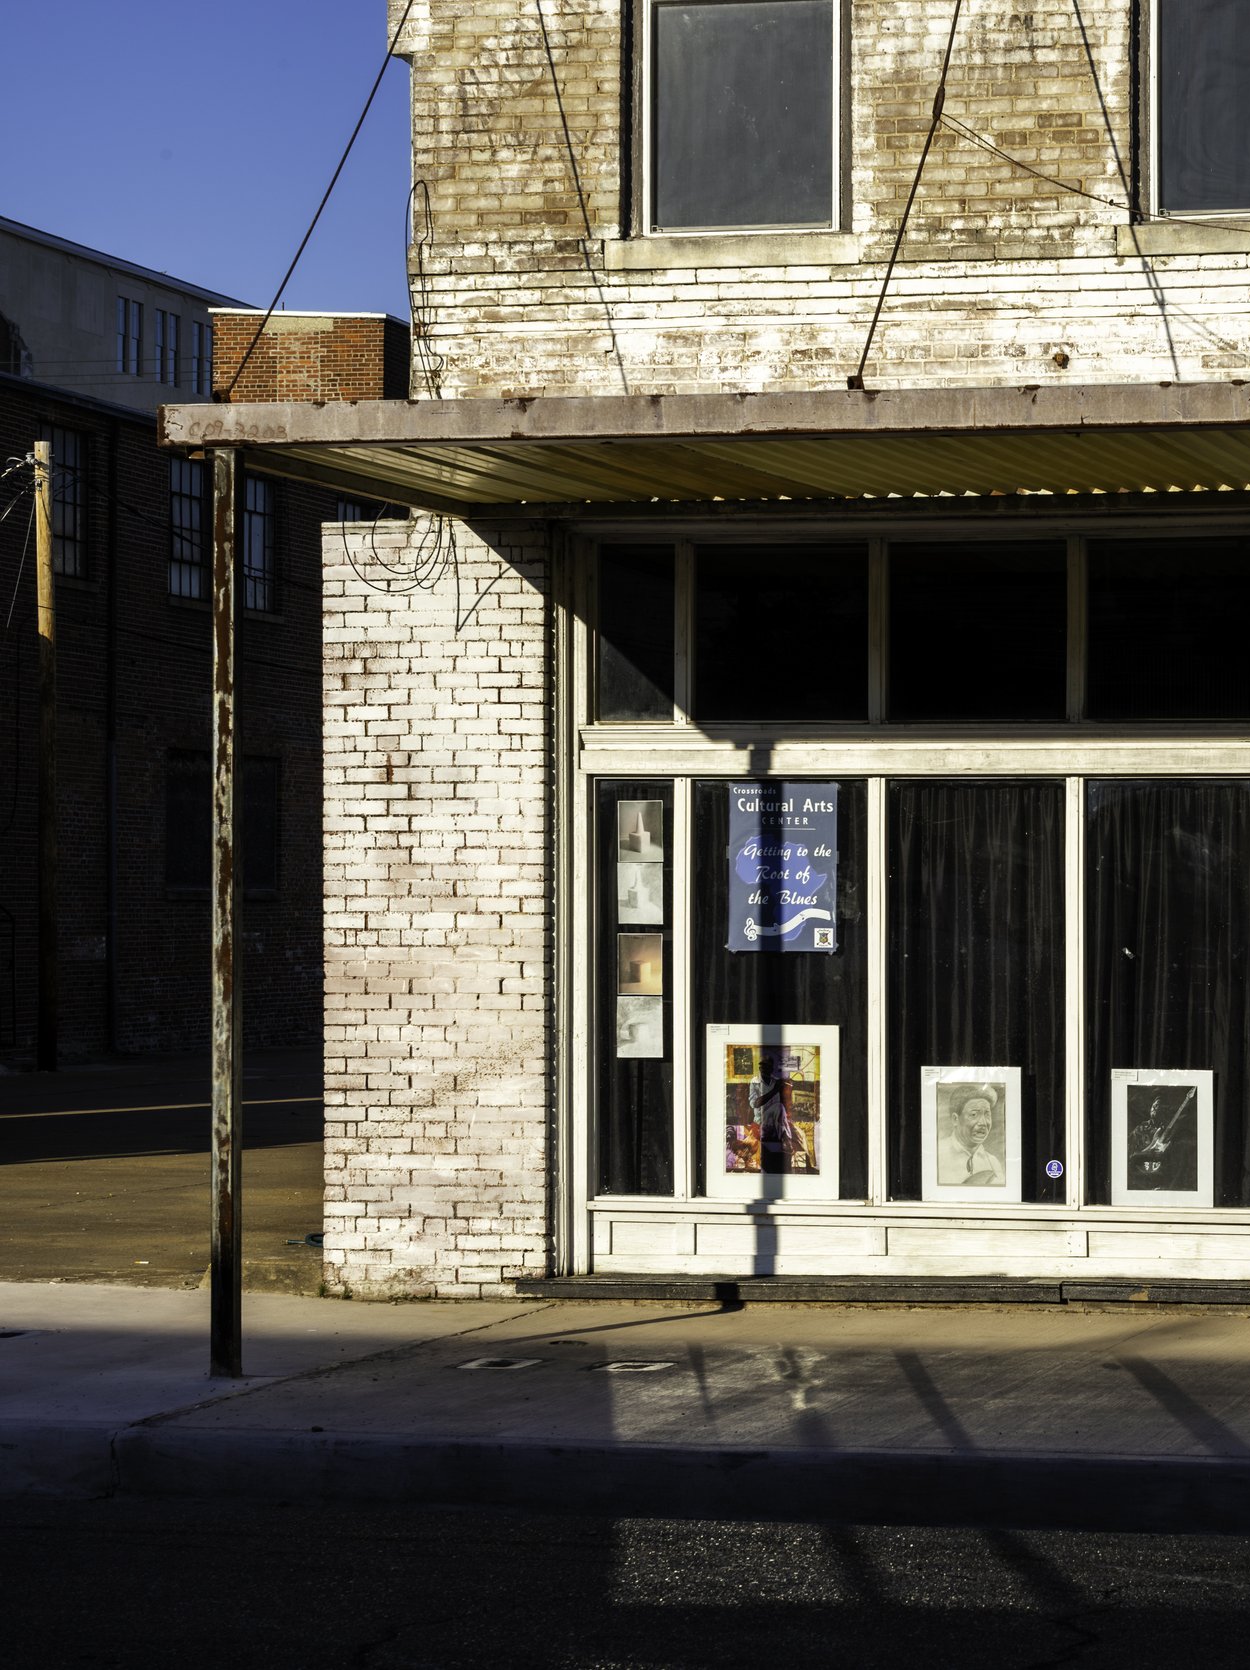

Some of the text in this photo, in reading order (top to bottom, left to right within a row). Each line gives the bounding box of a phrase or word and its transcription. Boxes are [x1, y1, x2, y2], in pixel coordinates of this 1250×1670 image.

[733, 787, 776, 795] Crossroads
[737, 798, 834, 812] Cultural Arts
[761, 817, 809, 825] CENTER
[743, 843, 832, 861] Getting to the
[756, 865, 811, 884] Root of
[747, 889, 818, 905] the Blues
